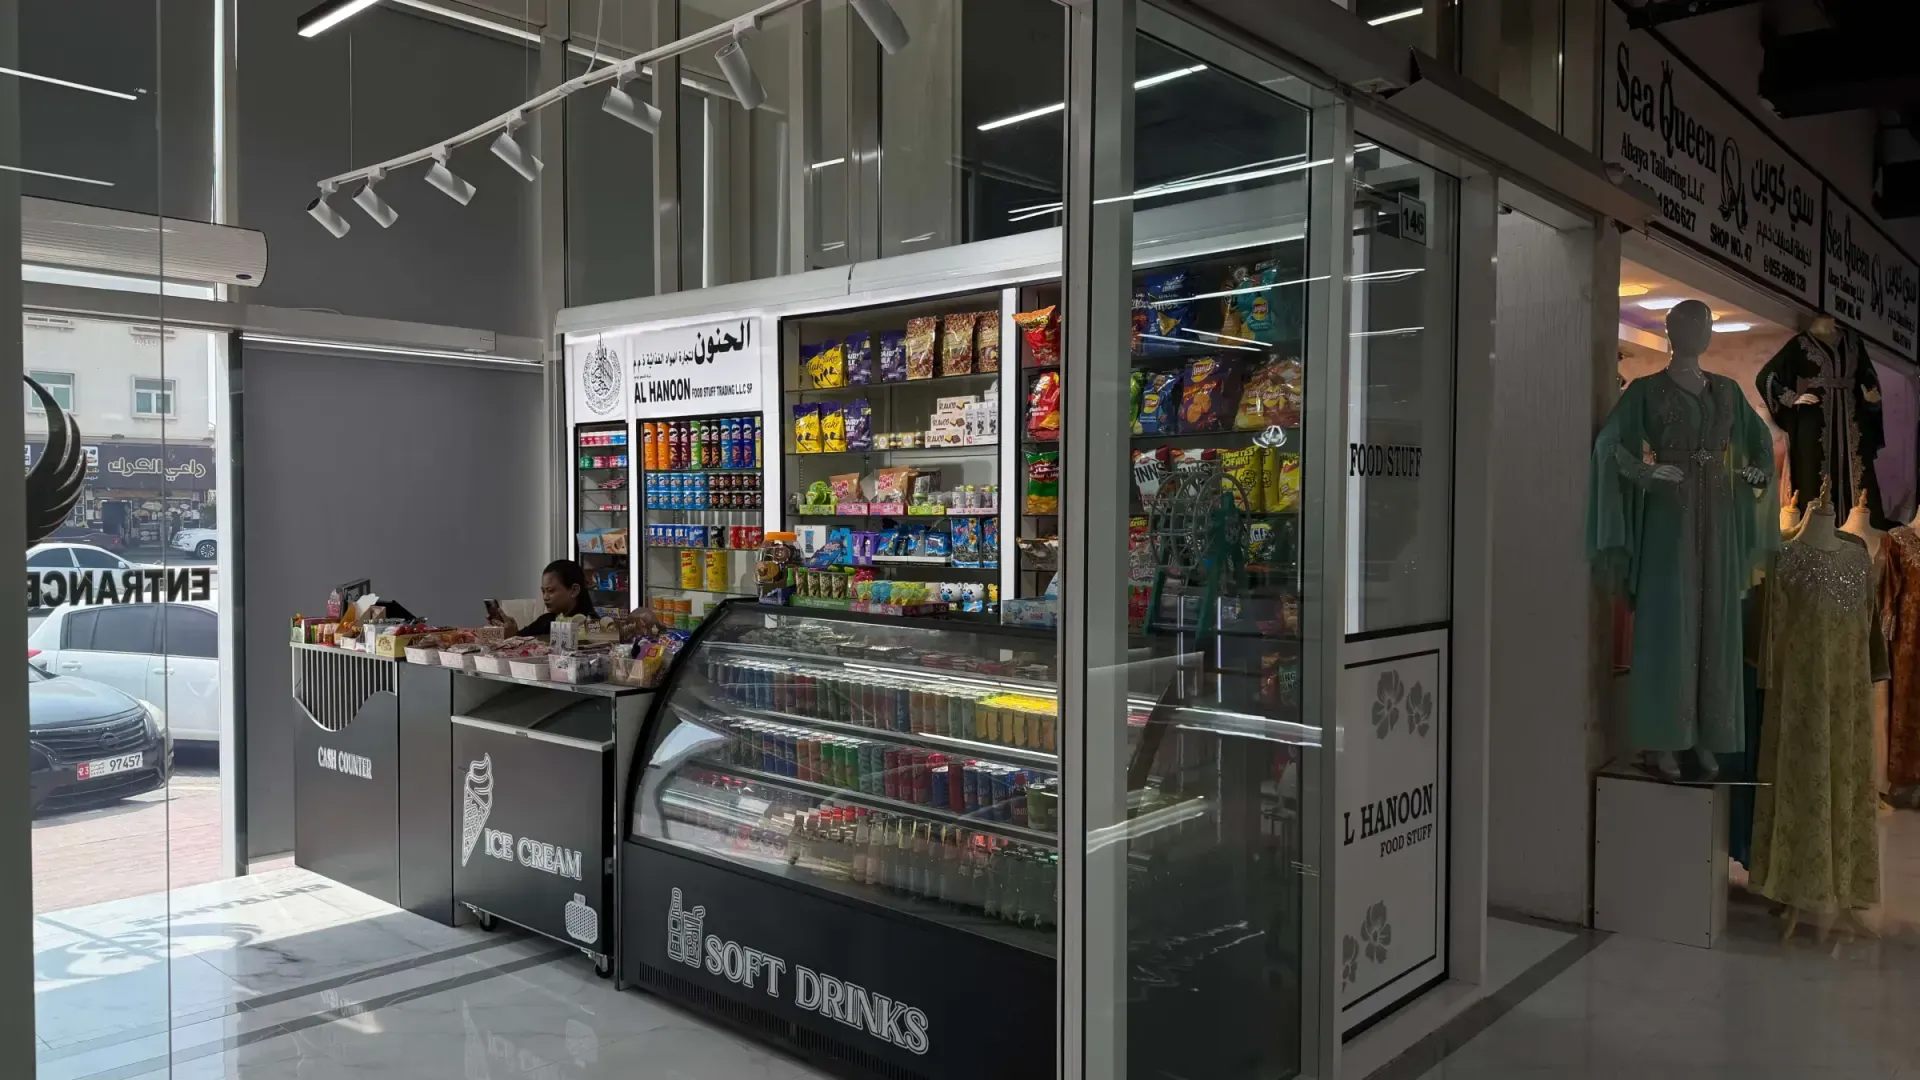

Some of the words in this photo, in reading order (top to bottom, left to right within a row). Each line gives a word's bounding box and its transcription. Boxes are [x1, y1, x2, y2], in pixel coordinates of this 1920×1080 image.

[1616, 41, 1655, 132] Sea
[1659, 60, 1716, 173] Queen
[1621, 132, 1649, 173] Abaya
[1649, 149, 1687, 200] Tailoring
[1751, 157, 1786, 215] كوين
[1403, 207, 1425, 236] 146
[1710, 222, 1730, 250] SHOP
[1826, 209, 1842, 261] Sea
[1844, 212, 1870, 282] Queen
[694, 317, 751, 365] الحنون
[634, 381, 647, 404] AL
[648, 377, 691, 403] HANOON
[692, 387, 703, 398] FOOD
[703, 385, 716, 398] STUFF
[716, 384, 735, 397] TRADING
[107, 456, 162, 478] الكرك
[163, 458, 207, 482] راعي
[1349, 443, 1383, 477] FOOD
[1387, 445, 1423, 477] STUFF
[109, 754, 141, 772] 97457
[318, 745, 338, 771] CASH
[338, 750, 373, 780] COUNTER
[1360, 782, 1434, 840] HANOON
[484, 827, 514, 862] ICE
[516, 837, 583, 881] CREAM
[1380, 829, 1405, 858] FOOD
[1406, 822, 1433, 847] STUFF
[704, 934, 787, 998] SOFT
[794, 964, 930, 1055] DRINKS
